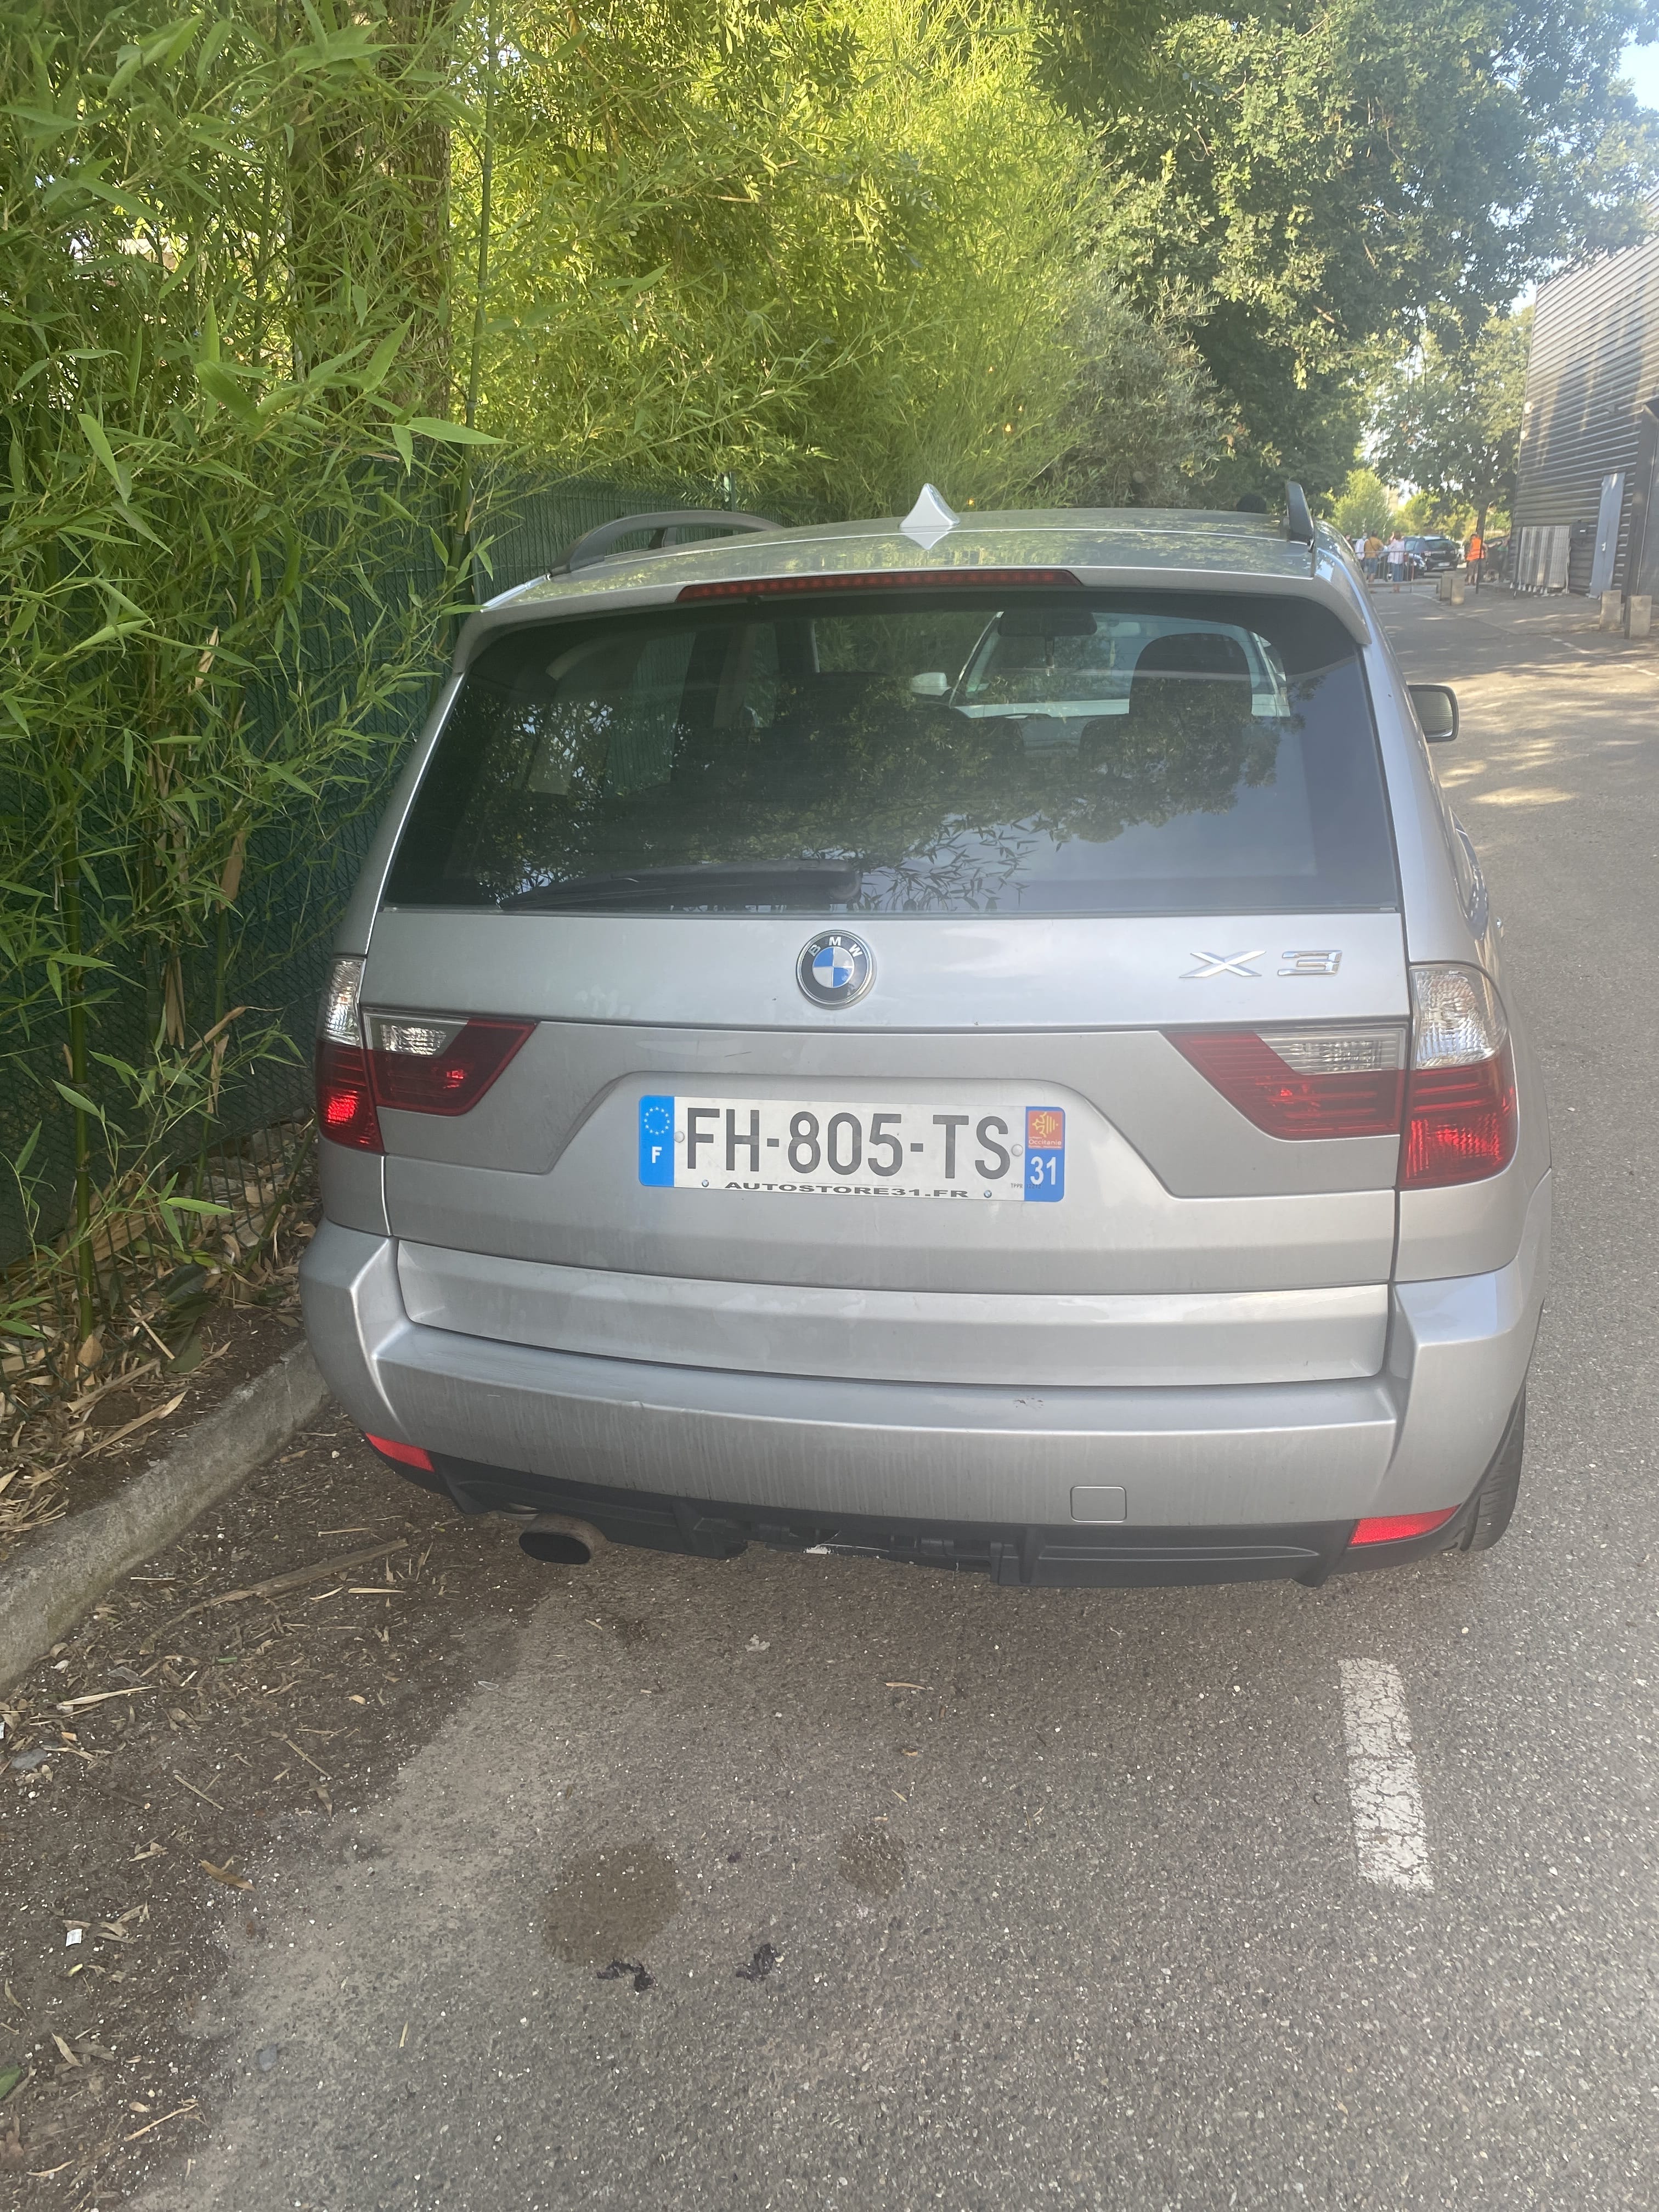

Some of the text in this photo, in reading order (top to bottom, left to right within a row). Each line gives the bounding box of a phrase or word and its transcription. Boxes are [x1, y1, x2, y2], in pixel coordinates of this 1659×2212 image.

[808, 936, 862, 957] BMW
[687, 1107, 1011, 1180] FH-805-TS
[652, 1146, 662, 1163] F
[1030, 1156, 1056, 1186] 31
[724, 1182, 969, 1198] AUTOSTORE31.FR
